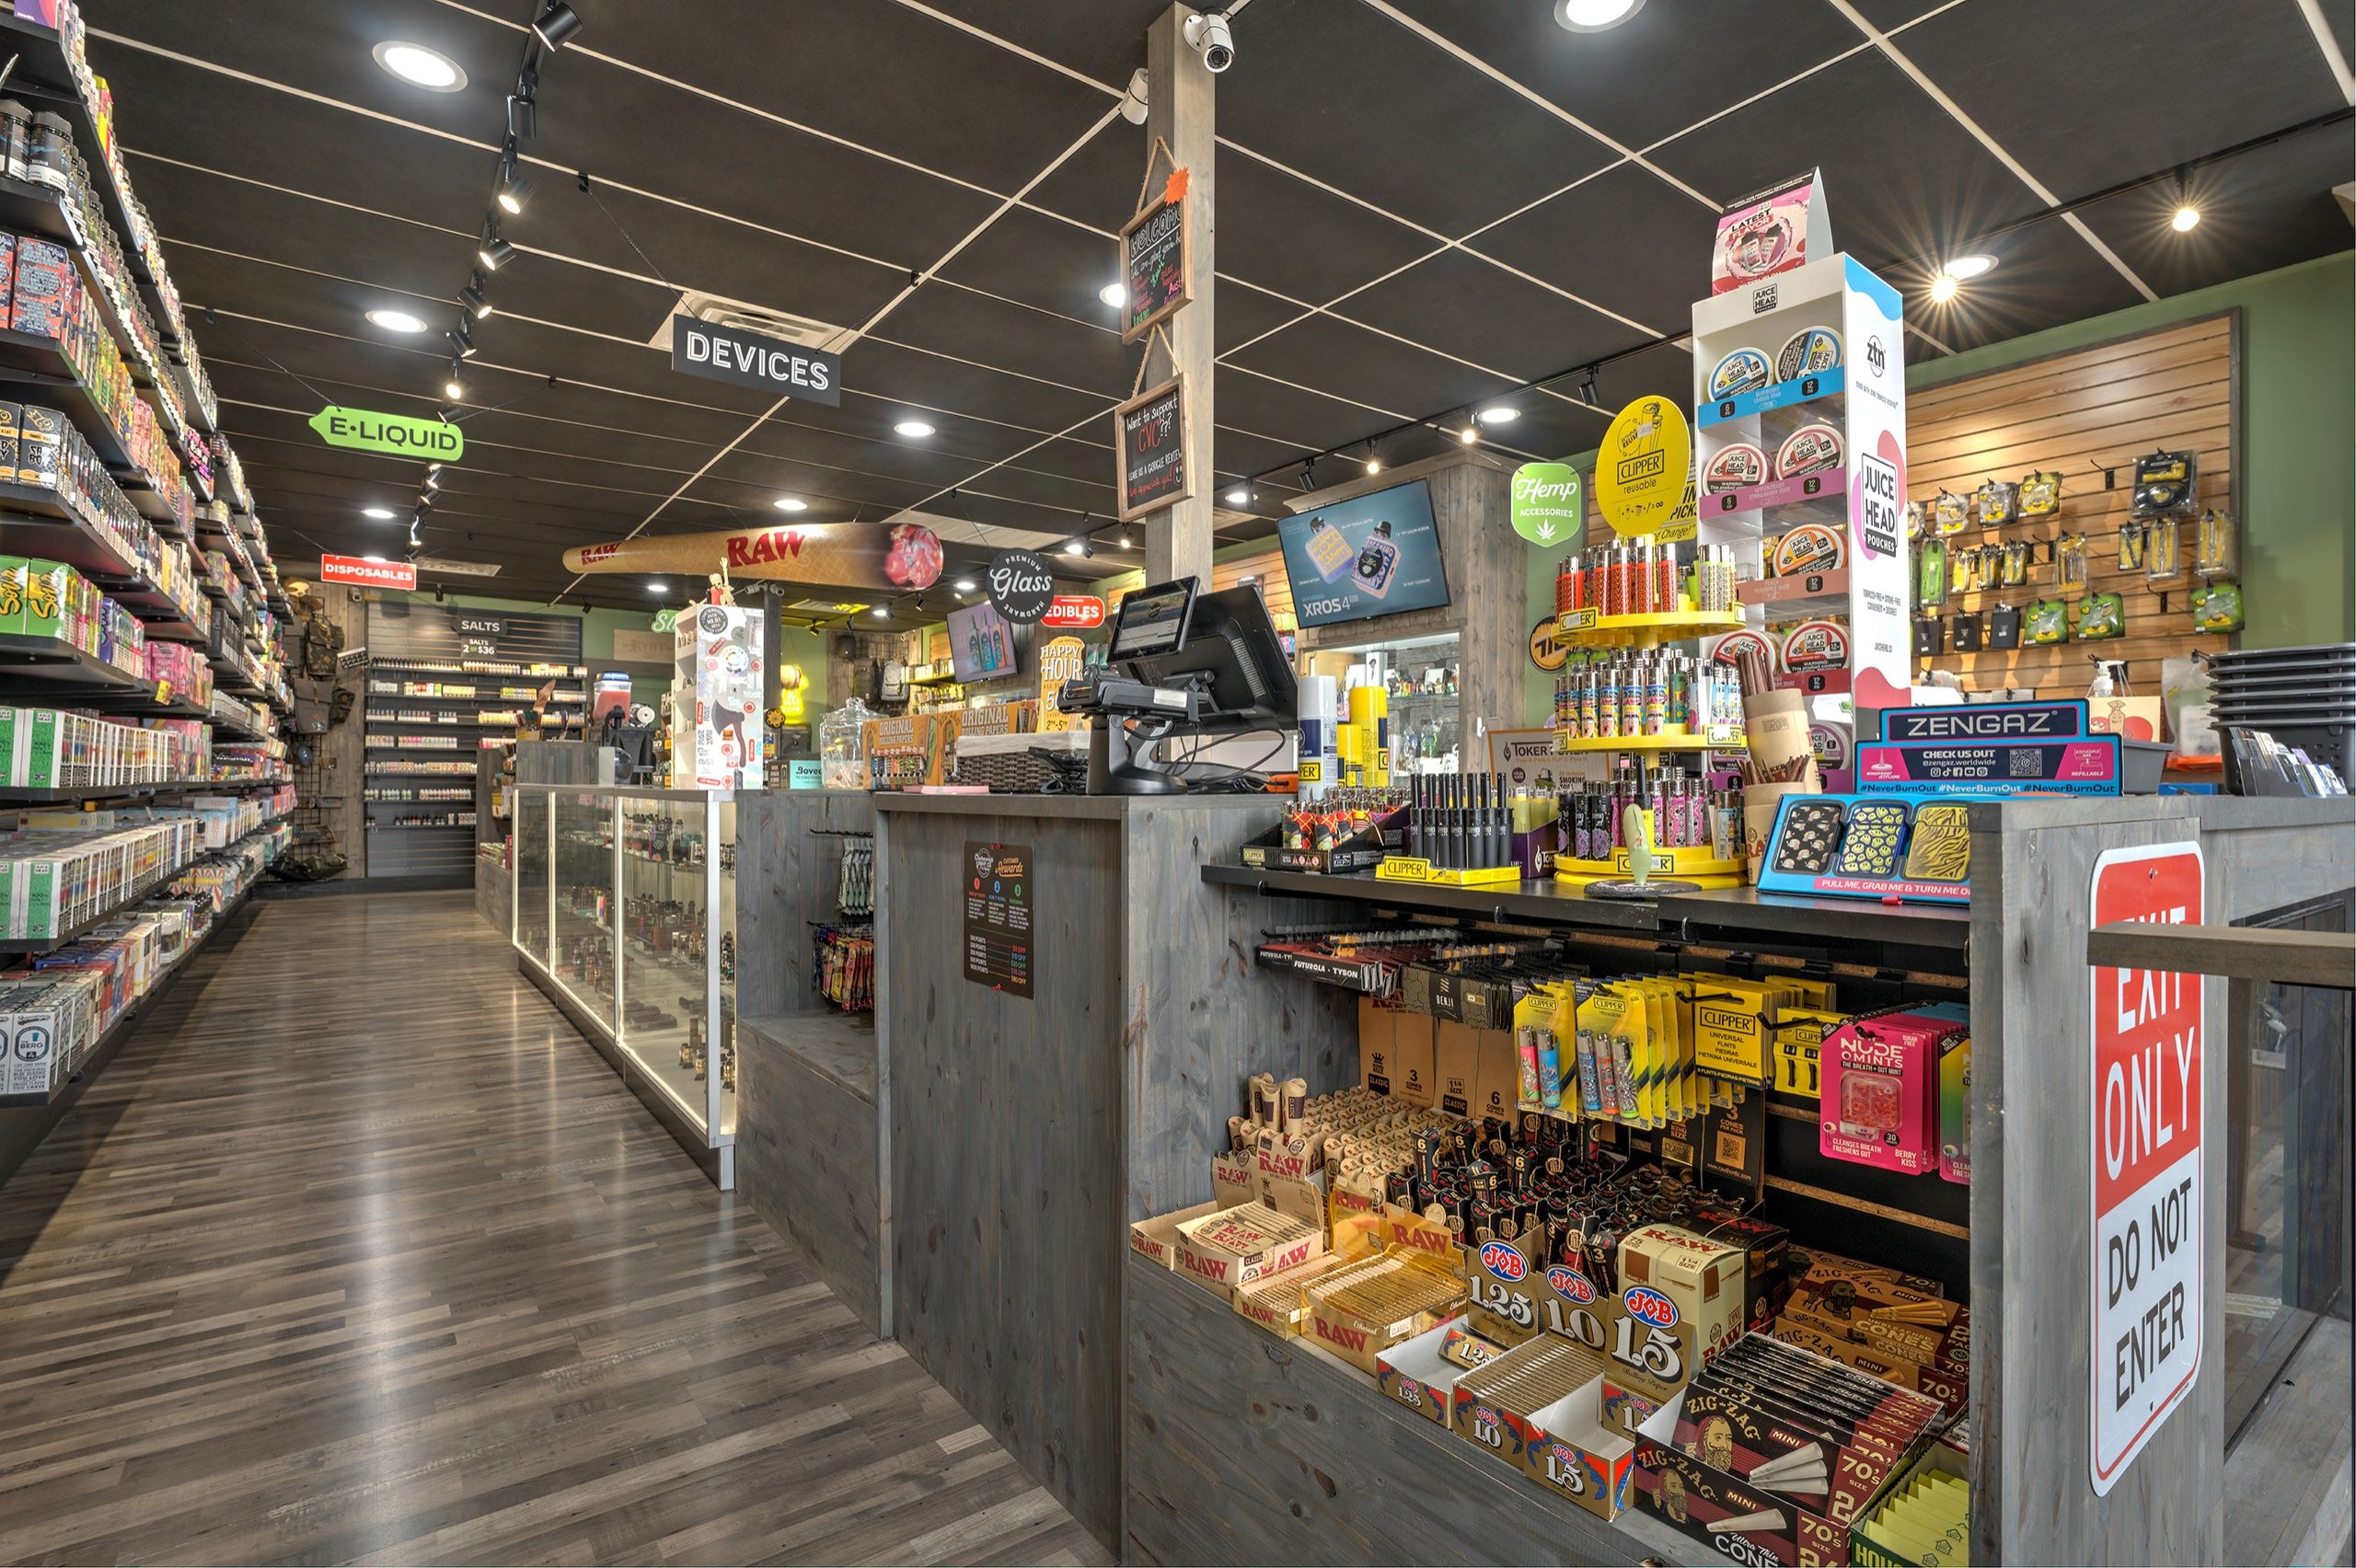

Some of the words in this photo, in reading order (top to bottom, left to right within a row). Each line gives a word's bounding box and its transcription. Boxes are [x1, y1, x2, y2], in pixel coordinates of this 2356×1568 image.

[1731, 209, 1771, 232] LATEST
[1732, 217, 1771, 239] FLAVOR
[1754, 287, 1775, 300] JUICE
[1755, 295, 1776, 308] HEAD
[687, 330, 829, 391] DEVICES
[1866, 341, 1885, 370] ztn
[1126, 412, 1141, 432] Want
[1151, 392, 1178, 421] support
[1138, 419, 1161, 453] CVC
[1148, 455, 1165, 474] GOOGLE
[1621, 455, 1660, 478] CLIPPER
[1515, 478, 1577, 502] Hemp
[1623, 478, 1657, 494] reusable
[1865, 465, 1895, 502] JUICE
[1519, 507, 1574, 518] ACCESSORIES
[1865, 499, 1896, 533] HEAD
[727, 530, 806, 569] RAW
[1867, 536, 1896, 552] POUCHES
[581, 542, 621, 566] RAW
[1005, 555, 1042, 571] PREMIUM
[325, 562, 413, 582] DISPOSABLES
[989, 568, 1052, 600] Glass
[1003, 601, 1045, 617] HARDWARE
[1303, 598, 1340, 617] XROS
[1341, 596, 1351, 610] 4
[461, 620, 501, 632] SALTS
[478, 645, 495, 655] $36
[1041, 645, 1080, 659] HAPPY
[1041, 657, 1083, 681] HOUR
[962, 706, 1009, 727] ORIGINAL
[1907, 713, 2050, 736] ZENGAZ
[879, 720, 914, 736] ORIGINAL
[1511, 742, 1548, 756] TOKER
[1923, 750, 1957, 759] CHECK
[1957, 750, 1972, 758] US
[1972, 750, 1995, 758] OUT
[1923, 758, 1996, 767] @zengaz.worldwide
[1860, 784, 1937, 792] #NeverBurnOut
[1938, 784, 2021, 792] #NeverBurnOut
[2023, 784, 2115, 793] #NeverBurnOut
[995, 861, 1023, 874] Rewards
[1388, 862, 1424, 876] CLIPPER
[1821, 880, 1843, 889] PULL
[1844, 880, 1861, 890] ME,
[1862, 882, 1886, 891] GRAB
[1888, 882, 1903, 891] ME
[1905, 883, 1913, 893] &
[1915, 884, 1941, 894] TURN
[1943, 886, 1959, 894] ME
[1294, 961, 1325, 974] FUTUROLA
[1333, 966, 1358, 978] TYSON
[2117, 907, 2188, 1035] EXIT
[1436, 995, 1454, 1008] BENJI
[1530, 998, 1554, 1009] CLIPPER
[1596, 1000, 1624, 1010] CLIPPER
[1704, 1012, 1750, 1031] CLIPPER
[1709, 1032, 1744, 1043] UNIVERSAL
[1715, 1048, 1738, 1057] PIEDRAS
[1841, 1038, 1903, 1059] NUDE
[1698, 1052, 1724, 1063] PIETRINA
[1724, 1056, 1758, 1068] UNIVERSALE
[1853, 1063, 1873, 1071] BREATH
[1369, 1076, 1388, 1088] CLASSIC
[1409, 1069, 1418, 1082] 3
[1449, 1087, 1463, 1095] SIZE
[1491, 1091, 1500, 1105] 6
[1444, 1098, 1466, 1111] CLASSIC
[2105, 1028, 2196, 1182] ONLY
[1720, 1119, 1744, 1130] CONES
[1833, 1138, 1859, 1149] CLEANSES
[1860, 1142, 1882, 1154] BREATH
[1887, 1132, 1897, 1141] 30
[1833, 1146, 1859, 1156] FRESHENS
[1860, 1149, 1871, 1158] GUT
[1895, 1149, 1917, 1159] BERRY
[1259, 1151, 1304, 1179] RAW
[1900, 1159, 1917, 1169] KISS
[1334, 1189, 1370, 1212] RAW
[1137, 1237, 1163, 1258] RAW
[1392, 1222, 1449, 1254] RAW
[1643, 1229, 1720, 1252] RAW
[2109, 1219, 2140, 1310] DO
[2151, 1177, 2191, 1272] NOT
[1183, 1249, 1229, 1281] RAW
[1244, 1254, 1264, 1267] CLASSIC
[1484, 1243, 1526, 1279] JOB
[1593, 1249, 1605, 1262] 3
[1678, 1262, 1697, 1271] SIZE
[1846, 1261, 1869, 1270] MINI
[1549, 1269, 1594, 1302] JOB
[1813, 1268, 1883, 1296] ZIG-ZAG
[1469, 1274, 1534, 1325] 1.25
[1895, 1291, 1922, 1303] MINI
[1242, 1300, 1273, 1324] RAW
[1627, 1293, 1678, 1326] JOB
[1353, 1320, 1378, 1335] Ethereal
[1391, 1320, 1411, 1336] CLASSIC
[1479, 1312, 1503, 1331] Rolling
[1504, 1322, 1524, 1338] Paper
[1544, 1297, 1606, 1349] 1.0
[1794, 1313, 1832, 1332] ZIG-ZAG
[1868, 1318, 1932, 1342] UNBLEACHED
[1315, 1317, 1369, 1353] RAW
[1855, 1320, 1934, 1353] CONES
[1611, 1316, 1683, 1379] 1.5
[1703, 1321, 1743, 1369] RAW
[1875, 1341, 1929, 1365] CONES
[2116, 1280, 2185, 1412] ENTER
[1857, 1358, 1885, 1373] MINI
[1400, 1377, 1419, 1393] JOB
[1622, 1367, 1647, 1385] Rolling
[1647, 1377, 1669, 1392] Paper
[1845, 1372, 1885, 1390] CONES
[1398, 1387, 1422, 1407] 1.25
[1922, 1378, 1958, 1403] 70's
[1632, 1397, 1651, 1412] JOB
[1477, 1408, 1500, 1425] JOB
[1687, 1395, 1761, 1442] ZIG-ZAG
[1472, 1417, 1502, 1448] 1.0
[1772, 1429, 1802, 1447] MINI
[1552, 1444, 1576, 1464] JOB
[1546, 1455, 1585, 1494] 1.5
[1636, 1446, 1718, 1502] ZIG-ZAG
[1842, 1455, 1881, 1486] 70's
[1849, 1480, 1868, 1492] SIZE
[1727, 1490, 1757, 1511] MINI
[1801, 1516, 1843, 1548] 70's
[1730, 1532, 1756, 1551] Ultra
[1757, 1545, 1780, 1562] Thin
[1811, 1541, 1831, 1553] SIZE
